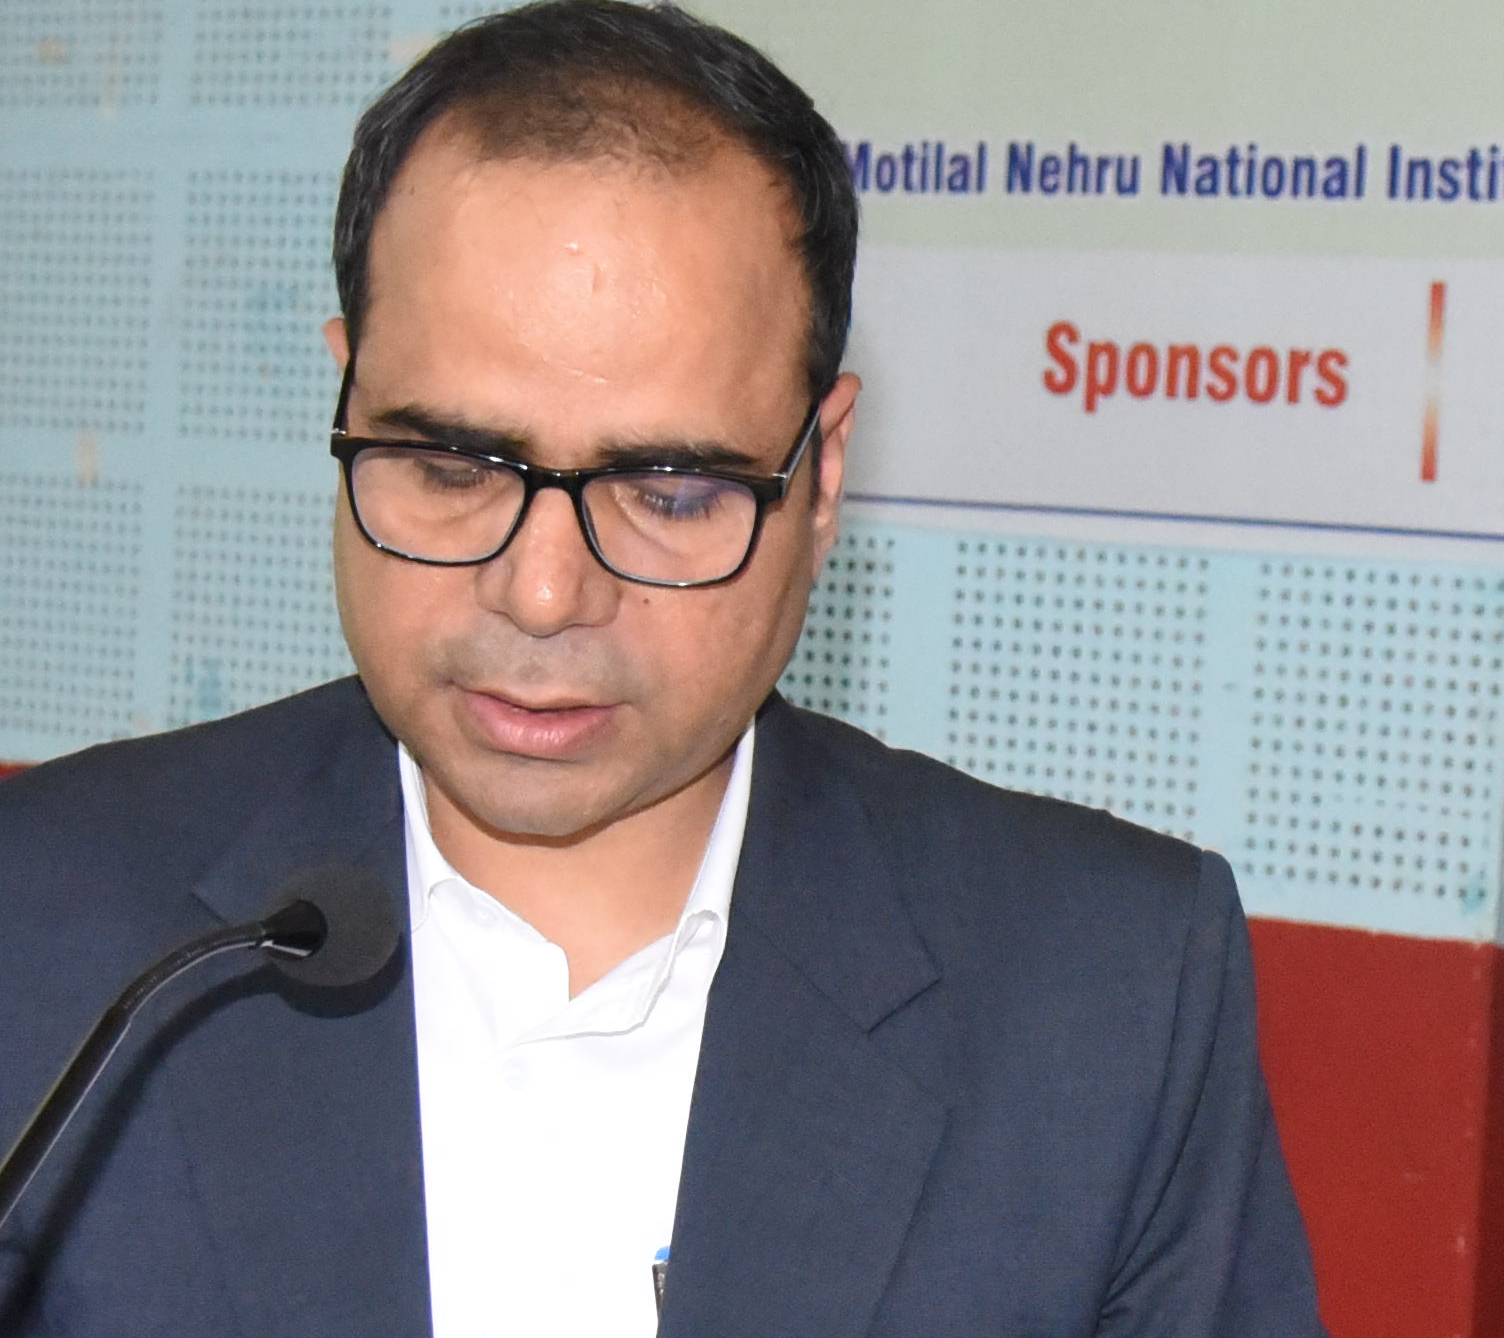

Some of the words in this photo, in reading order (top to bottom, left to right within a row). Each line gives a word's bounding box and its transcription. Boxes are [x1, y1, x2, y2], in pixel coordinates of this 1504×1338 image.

[1006, 142, 1142, 197] Nehru
[1160, 143, 1369, 202] National
[1041, 320, 1350, 415] Sponsors
